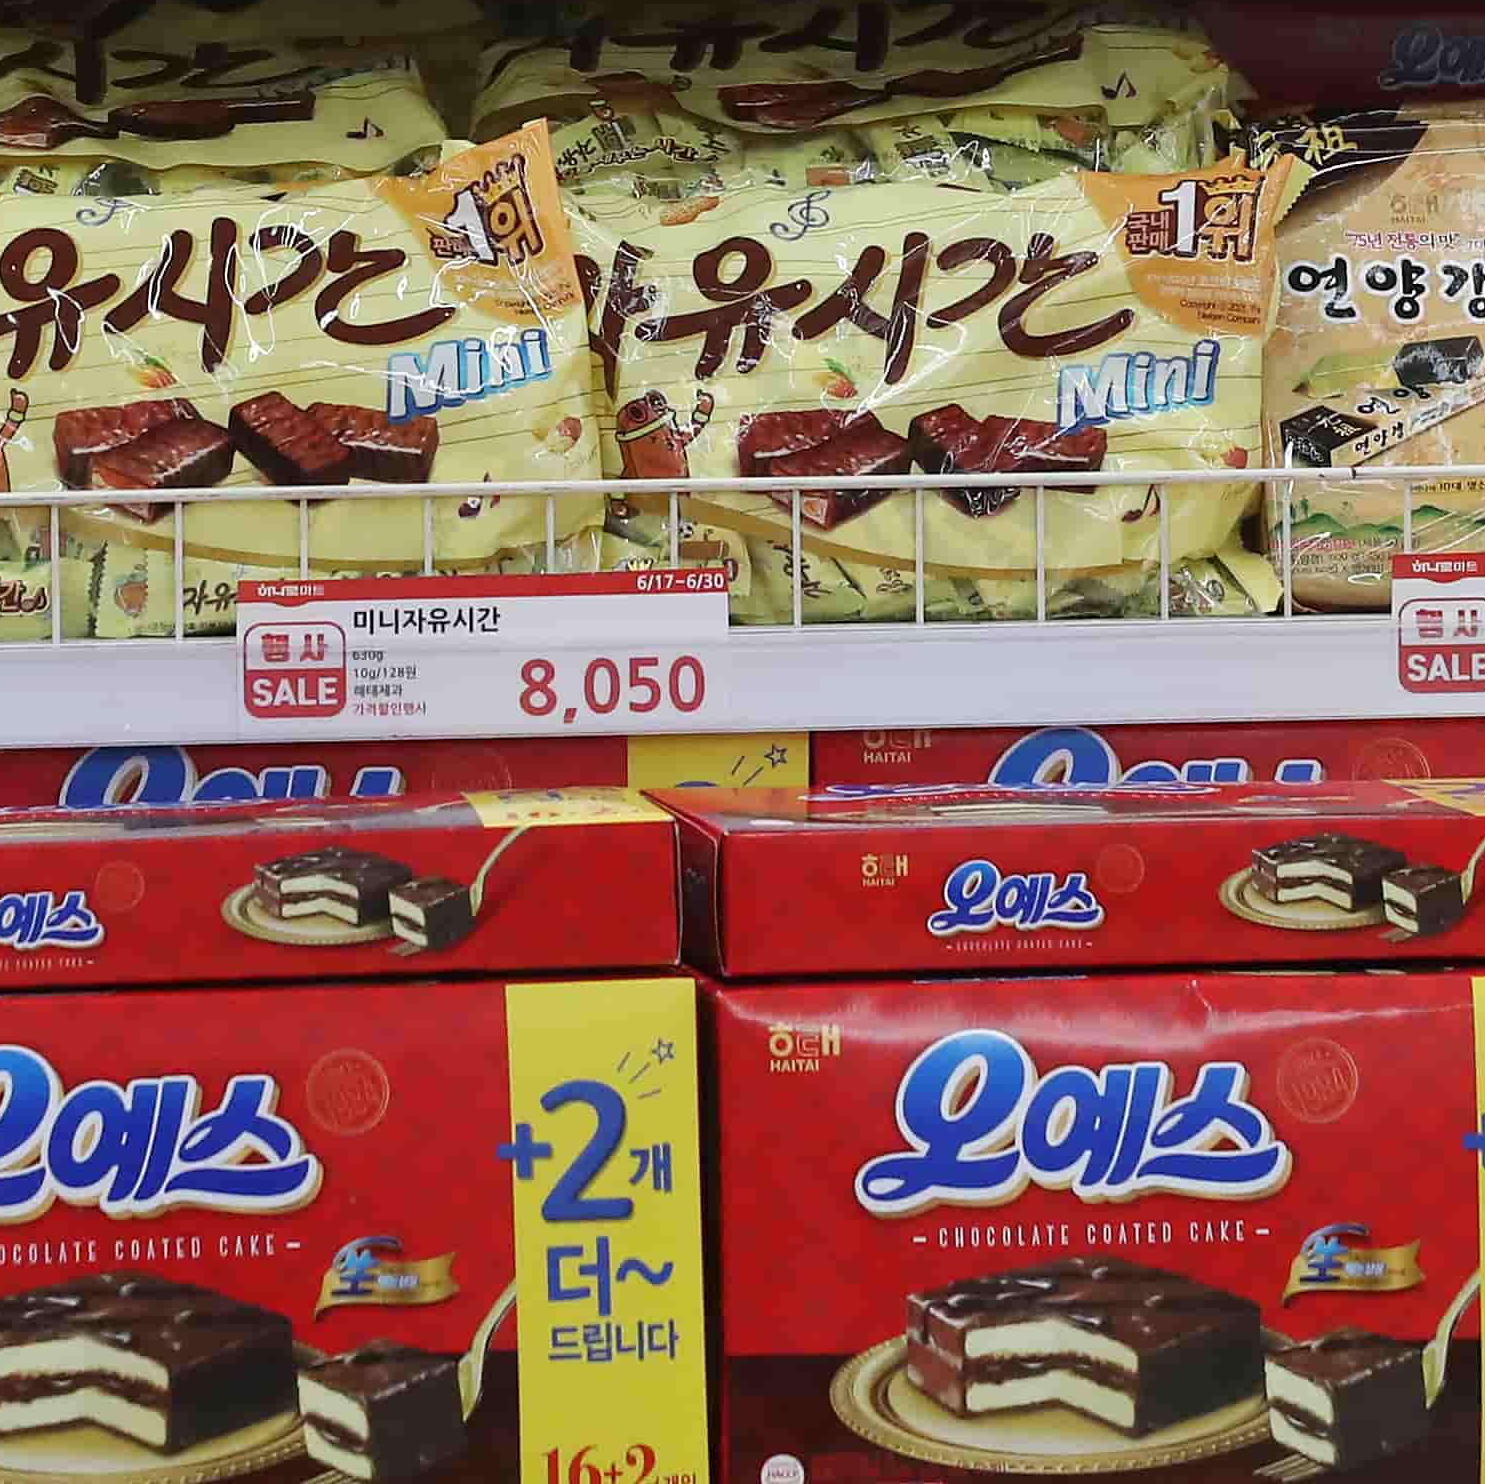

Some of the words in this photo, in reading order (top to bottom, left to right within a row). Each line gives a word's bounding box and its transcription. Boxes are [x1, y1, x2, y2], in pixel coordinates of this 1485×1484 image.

[1128, 212, 1170, 229] 국내
[1160, 180, 1257, 261] 1위
[1127, 230, 1169, 252] 판매
[384, 328, 552, 424] Mini
[1056, 339, 1220, 436] Mini
[636, 572, 726, 593] 6/17~6/30
[353, 606, 501, 636] 미니자유시간
[252, 676, 340, 708] SALE
[519, 657, 708, 724] 8,050
[926, 859, 1106, 937] 오예스
[770, 1060, 821, 1073] HAITAI
[855, 1028, 1293, 1220] 오예스
[115, 1235, 203, 1261] COATED
[219, 1234, 277, 1257] CAKE
[938, 1223, 1070, 1249] CHOCOLATE
[1087, 1221, 1172, 1245] COATED
[1190, 1219, 1245, 1242] CAKE
[547, 1322, 681, 1364] 드립니다
